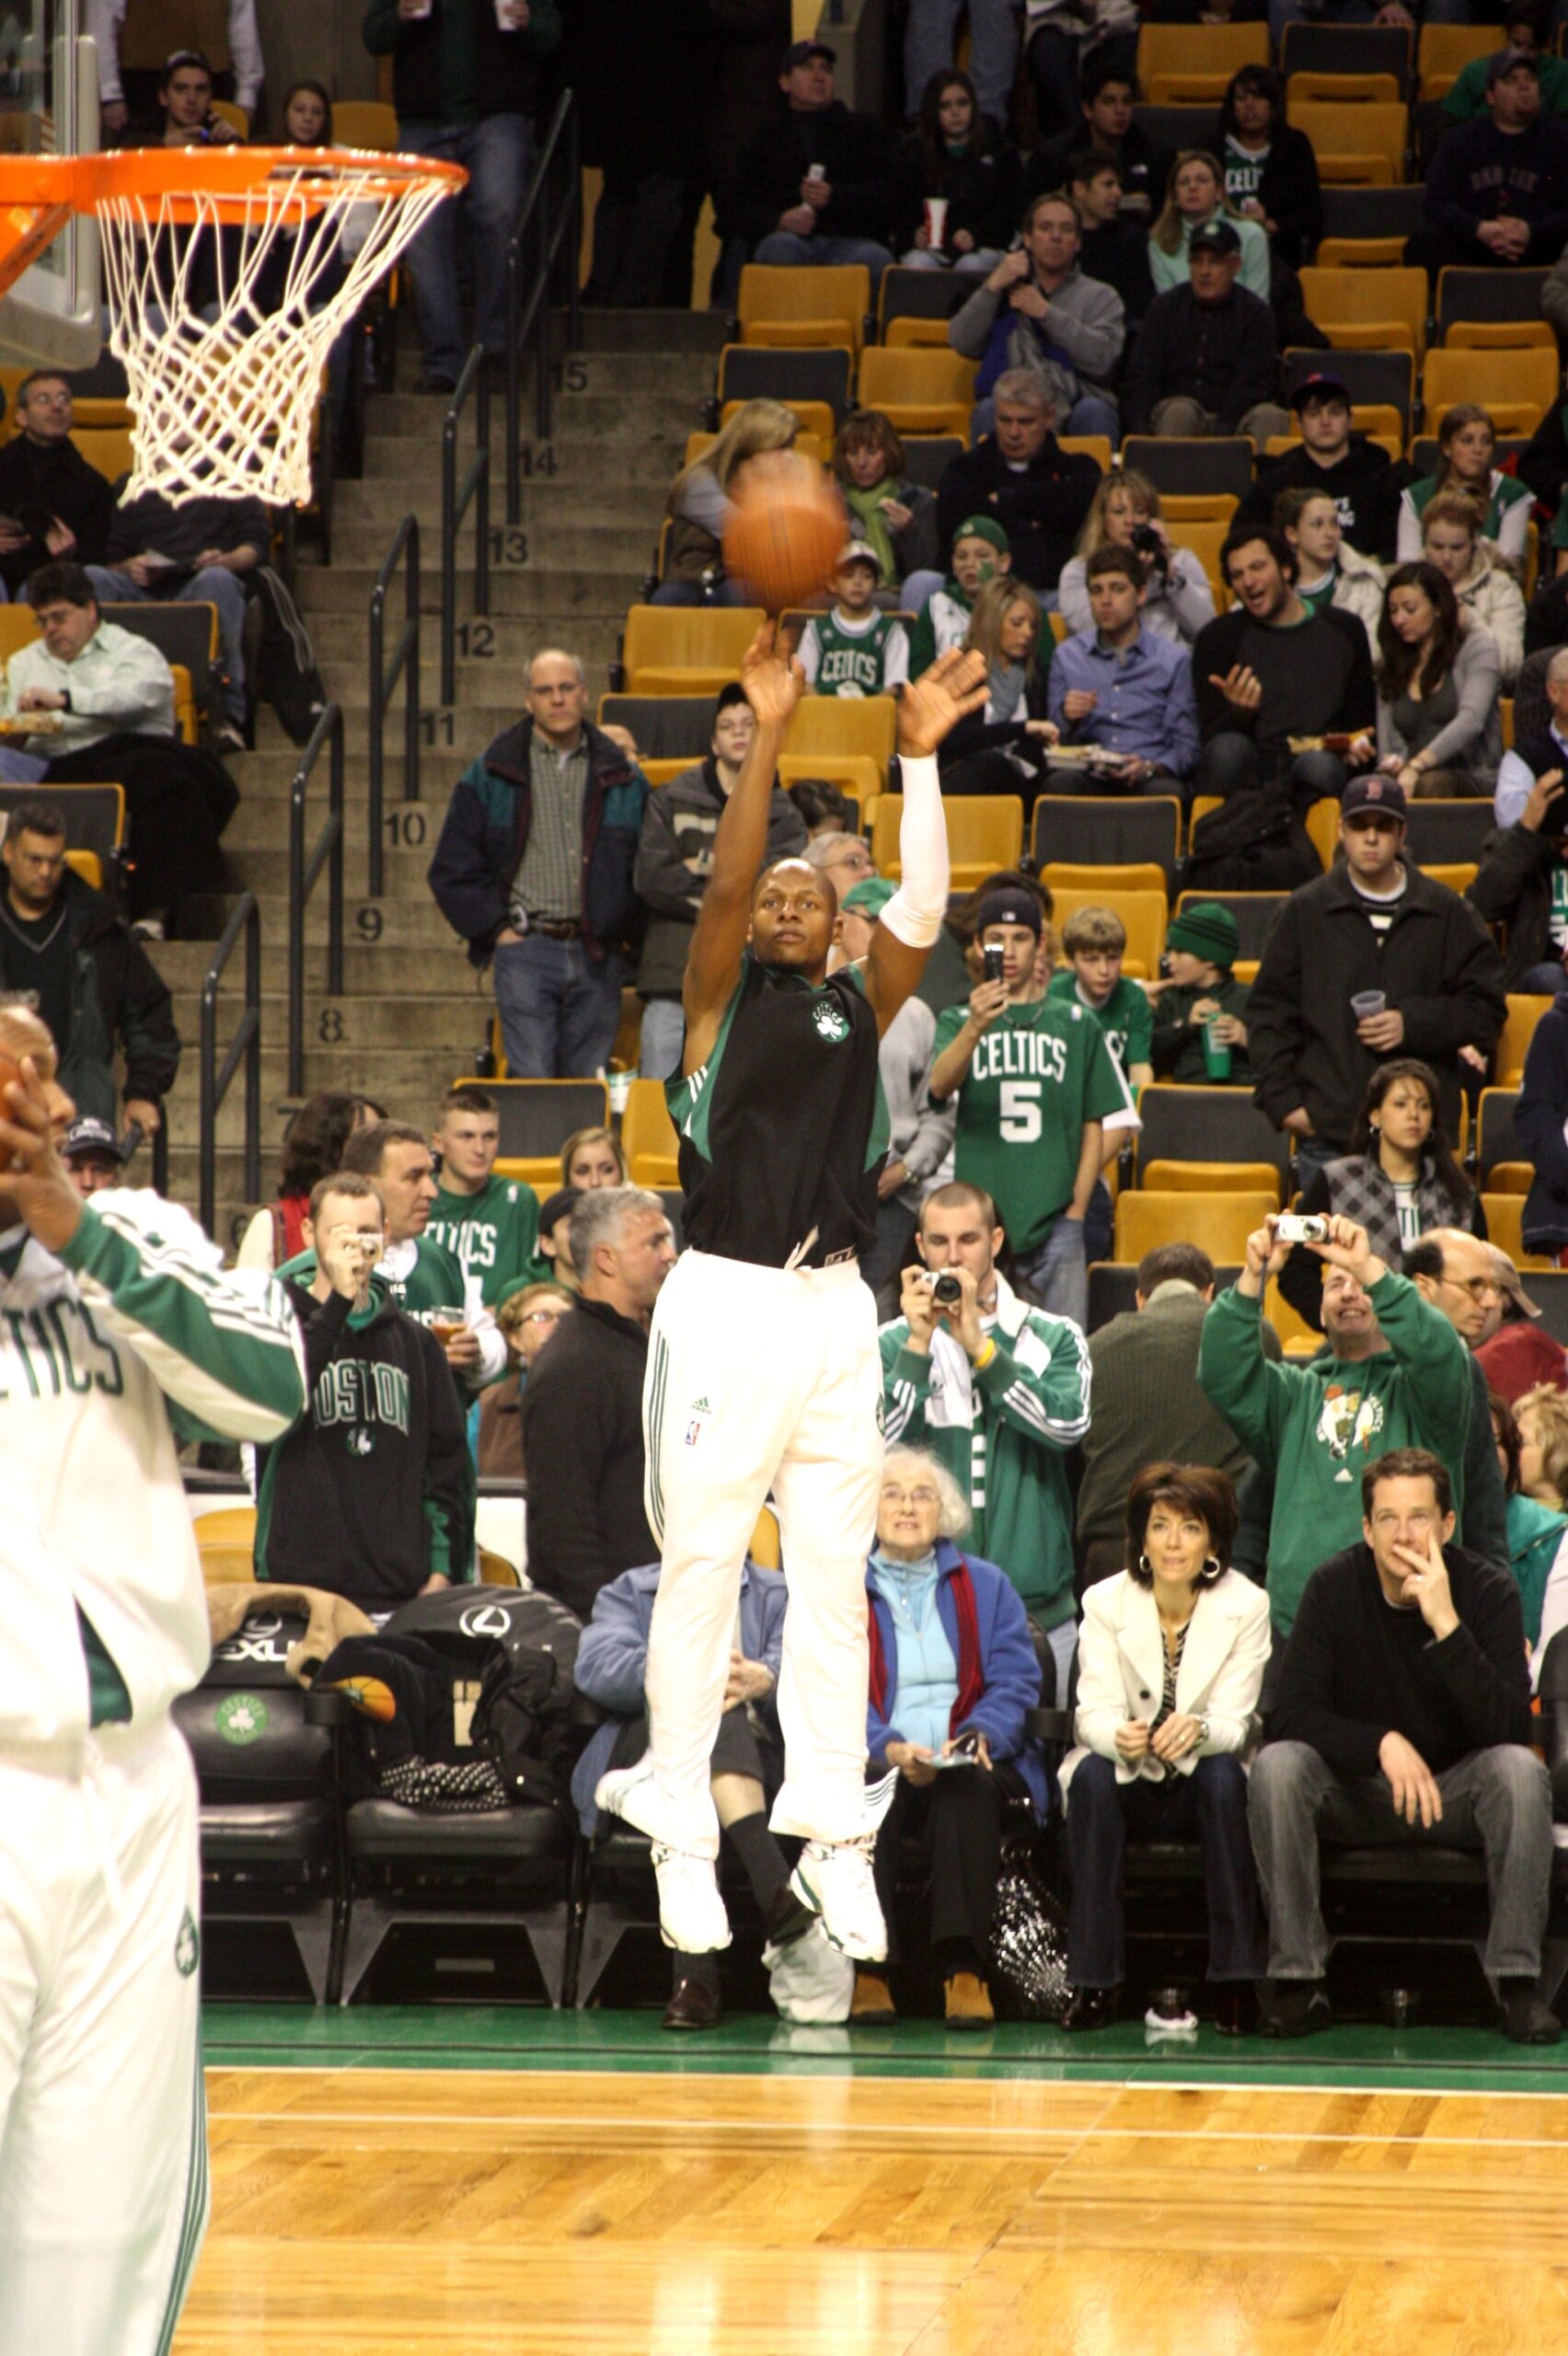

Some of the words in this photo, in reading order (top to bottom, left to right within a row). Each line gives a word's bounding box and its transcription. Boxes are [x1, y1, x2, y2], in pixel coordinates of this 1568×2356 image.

[552, 359, 588, 392] 15
[522, 446, 558, 477] 14
[490, 531, 528, 564] 13
[455, 623, 495, 658] 12
[420, 712, 455, 745] 11
[385, 812, 426, 846] 10
[356, 907, 383, 941] 9
[318, 1009, 343, 1043] 8
[973, 1030, 1067, 1084] CELTICS
[277, 1108, 302, 1143] 7
[999, 1080, 1042, 1143] 5
[0, 1294, 123, 1398] TICS
[211, 1639, 296, 1662] EXU
